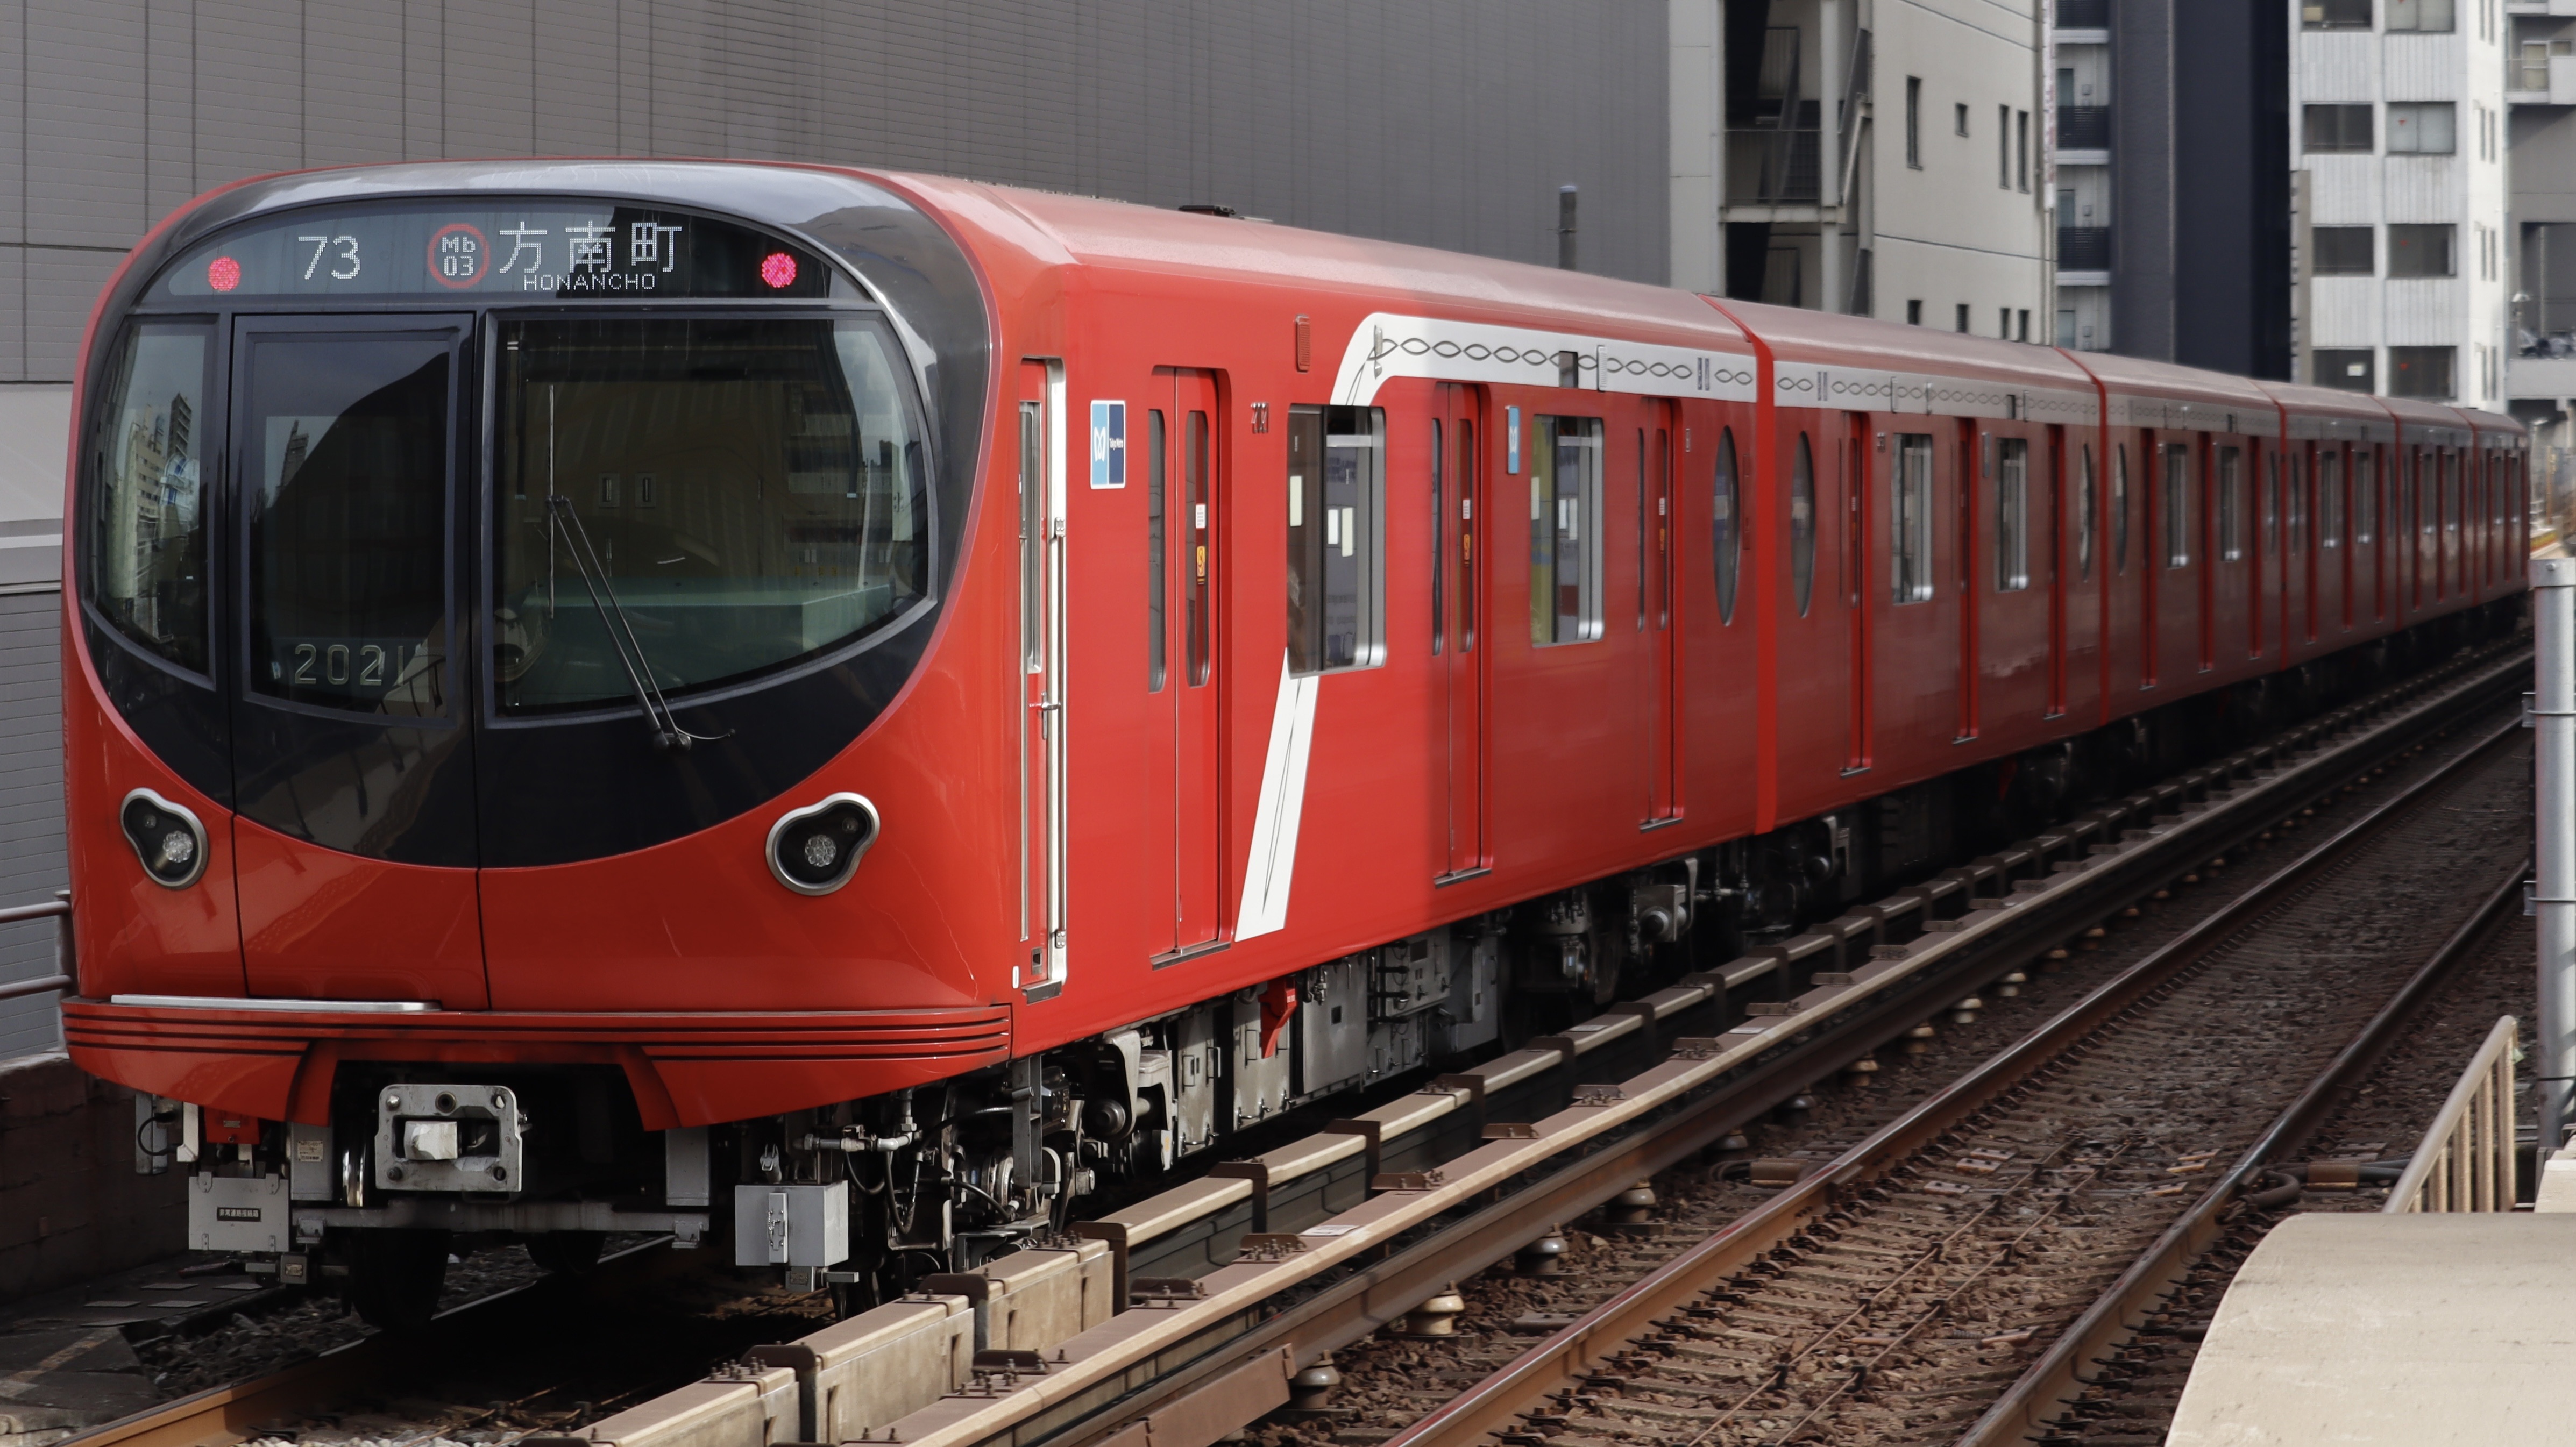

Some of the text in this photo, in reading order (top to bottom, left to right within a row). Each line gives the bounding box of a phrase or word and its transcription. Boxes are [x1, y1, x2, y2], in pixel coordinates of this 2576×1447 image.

[298, 236, 360, 280] 73
[442, 237, 476, 253] Mb
[499, 220, 683, 273] 方南町
[444, 256, 473, 276] 03
[524, 273, 655, 290] HONANCHO
[294, 644, 404, 686] 2021
